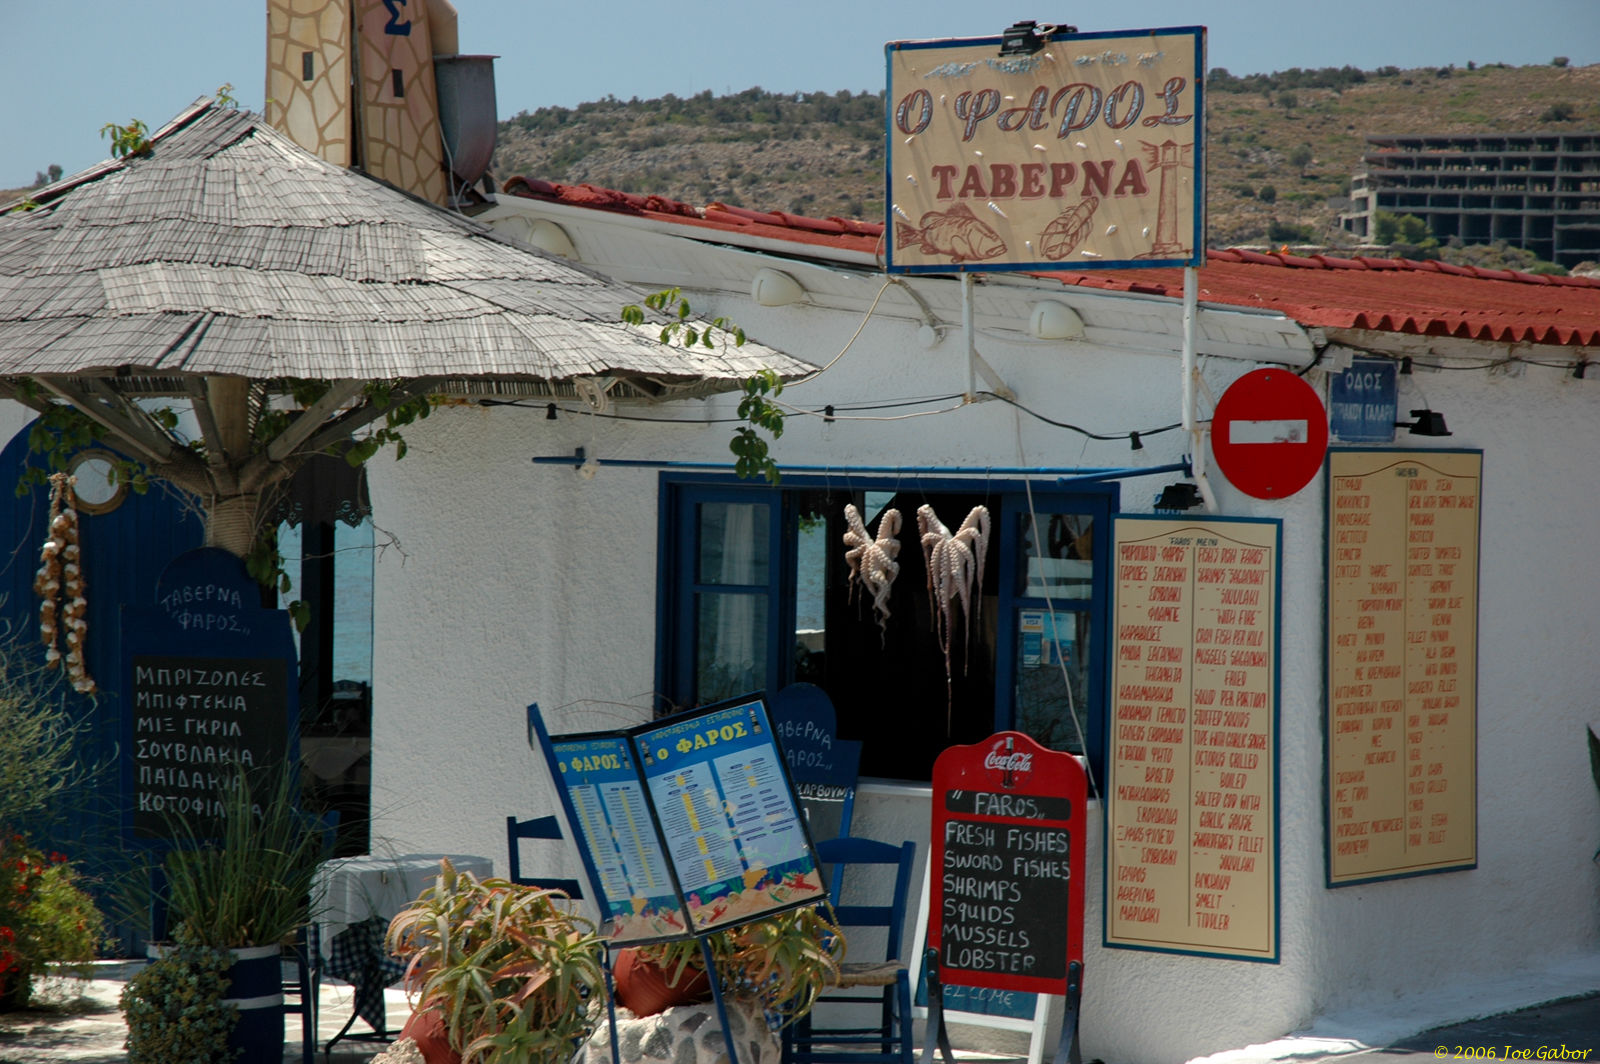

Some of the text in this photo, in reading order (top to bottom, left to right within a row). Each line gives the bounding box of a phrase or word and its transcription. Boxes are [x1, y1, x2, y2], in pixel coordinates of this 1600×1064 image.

[931, 159, 1149, 200] ΤΑΒΕΡΝΑ
[1346, 373, 1382, 390] ΟΔΟΣ
[161, 584, 242, 612] ΤΑΒΕΡΝΑ
[136, 666, 266, 686] ΜΠΡΙΖΟΛΕΣ
[137, 691, 247, 711] ΜΠΙΦΤΕΚΙΑ
[138, 718, 241, 736] ΜΙΞ ΓΚΡΙΛ
[676, 722, 748, 753] ΦΑΡΟΣ
[778, 721, 831, 750] ΑΒΕΡΝΑ
[137, 739, 253, 766] ΣΟΥΒΛΑΚΙΑ
[571, 754, 620, 772] ΦΑΡΟΣ
[1220, 772, 1247, 789] BOILED
[1195, 791, 1222, 808] SALTED
[1240, 795, 1261, 810] WITH
[946, 821, 1068, 852] FRESH FISHES
[1238, 836, 1264, 853] FILLET
[944, 851, 1070, 879] SWORD FISHES
[943, 874, 1021, 902] SHRIMPS
[1196, 894, 1222, 909] SMELT
[943, 924, 1030, 948] MUSSELS
[946, 944, 1036, 971] LOBSTER
